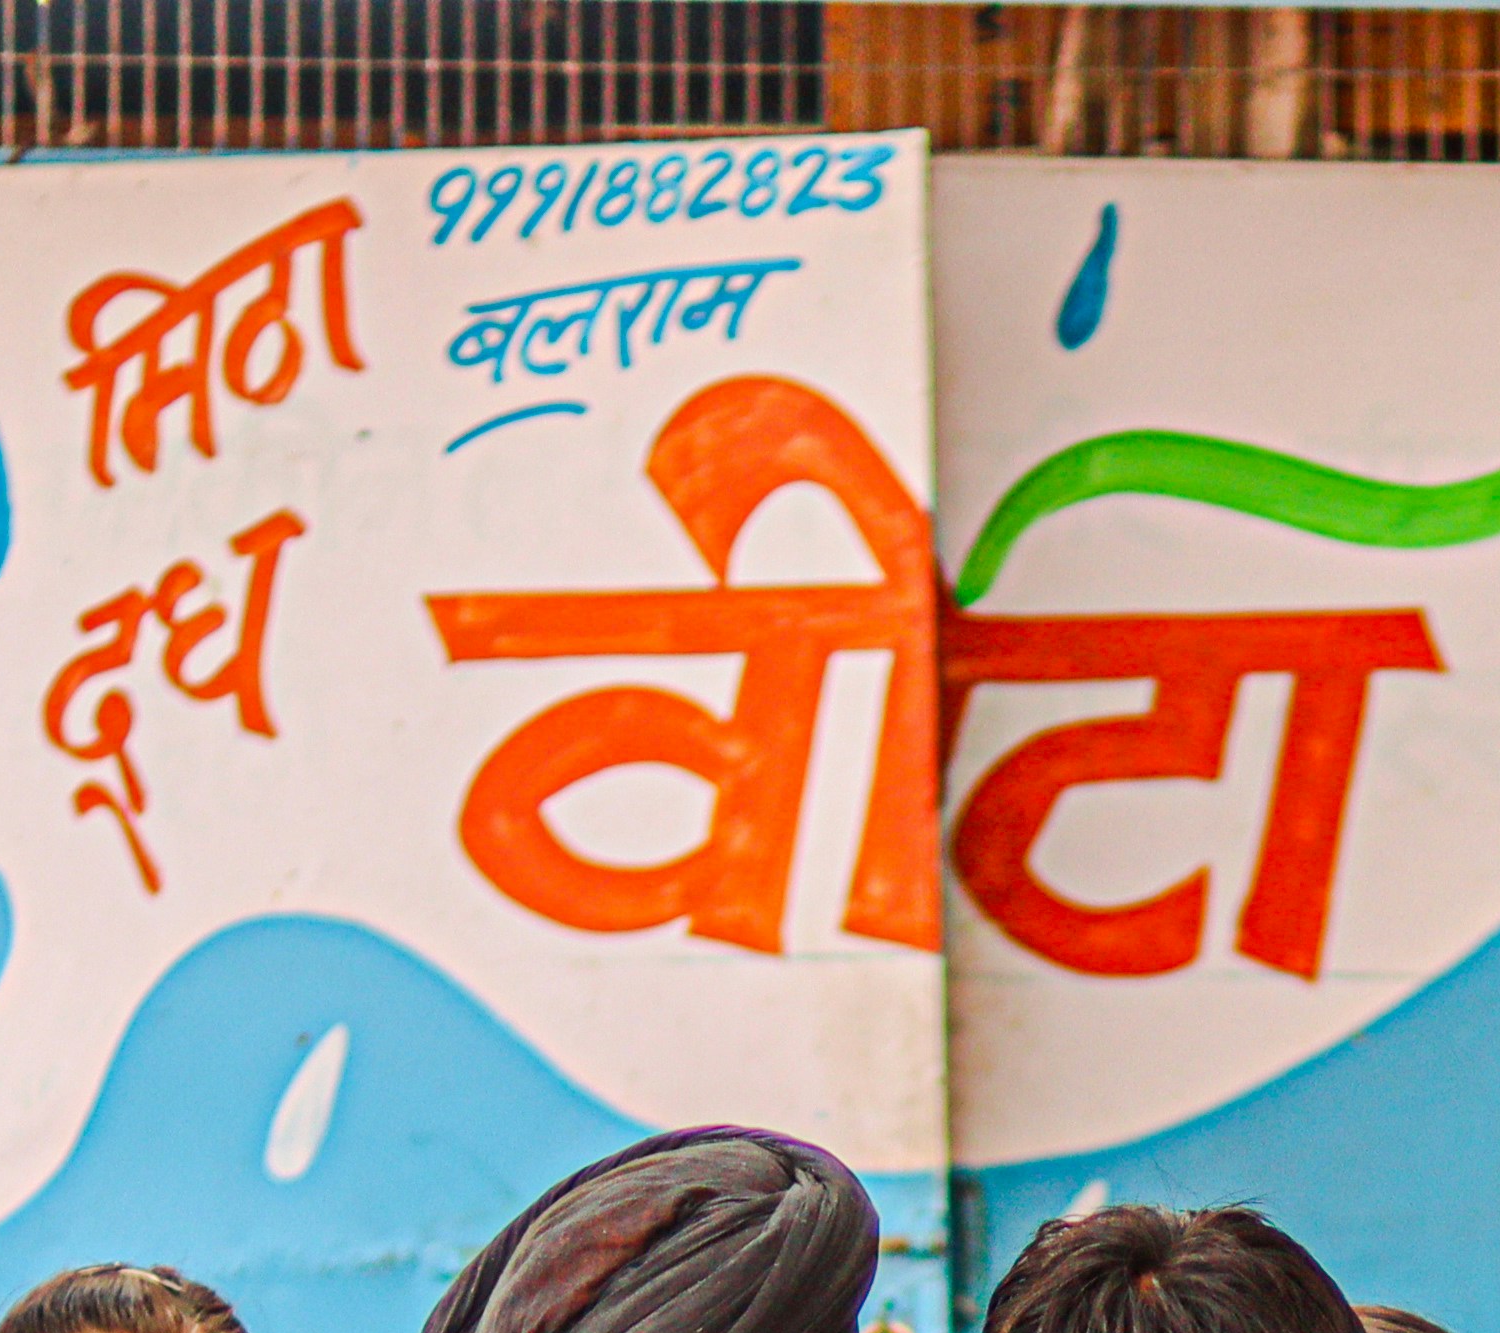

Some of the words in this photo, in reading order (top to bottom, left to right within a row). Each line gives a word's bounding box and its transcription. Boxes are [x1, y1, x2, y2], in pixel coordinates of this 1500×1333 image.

[428, 143, 898, 247] 9991882823
[448, 258, 803, 383] बलराम
[41, 508, 307, 895] दूध
[421, 373, 1449, 985] वीटा
